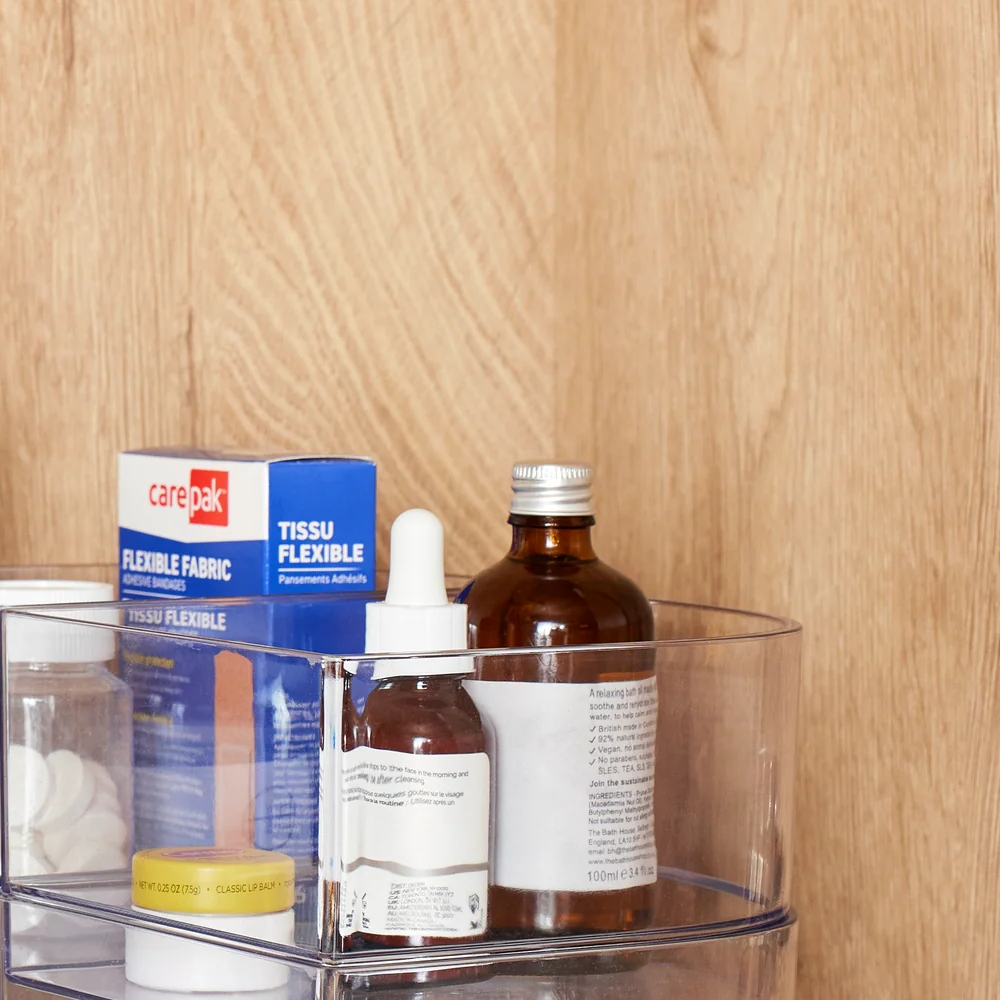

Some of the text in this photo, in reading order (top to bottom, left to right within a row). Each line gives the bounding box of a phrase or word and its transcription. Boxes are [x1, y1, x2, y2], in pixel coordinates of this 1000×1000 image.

[149, 477, 223, 518] carepak
[277, 521, 335, 541] TISSU
[277, 544, 365, 564] FLEXIBLE
[122, 548, 232, 582] FLEXIBLE FABRIC
[278, 571, 368, 585] Pansements Adhésifs
[128, 608, 163, 625] TISSU
[164, 609, 227, 632] FLEXIBLE
[589, 688, 596, 698] A
[596, 688, 625, 700] relaxing
[616, 702, 629, 710] and
[598, 725, 622, 733] British
[598, 756, 609, 764] No
[404, 766, 418, 775] face
[432, 771, 458, 779] morning
[458, 770, 469, 778] and
[589, 779, 605, 788] Join
[445, 790, 465, 799] visage
[588, 790, 633, 800] INGREDIENTS
[588, 828, 601, 837] The
[601, 828, 617, 836] Bath
[588, 869, 619, 882] 100ml
[138, 880, 148, 890] NET
[157, 883, 170, 893] 0.25
[170, 884, 181, 894] OZ
[216, 884, 246, 895] CLASSIC
[248, 883, 258, 893] LIP
[258, 881, 276, 892] BALM
